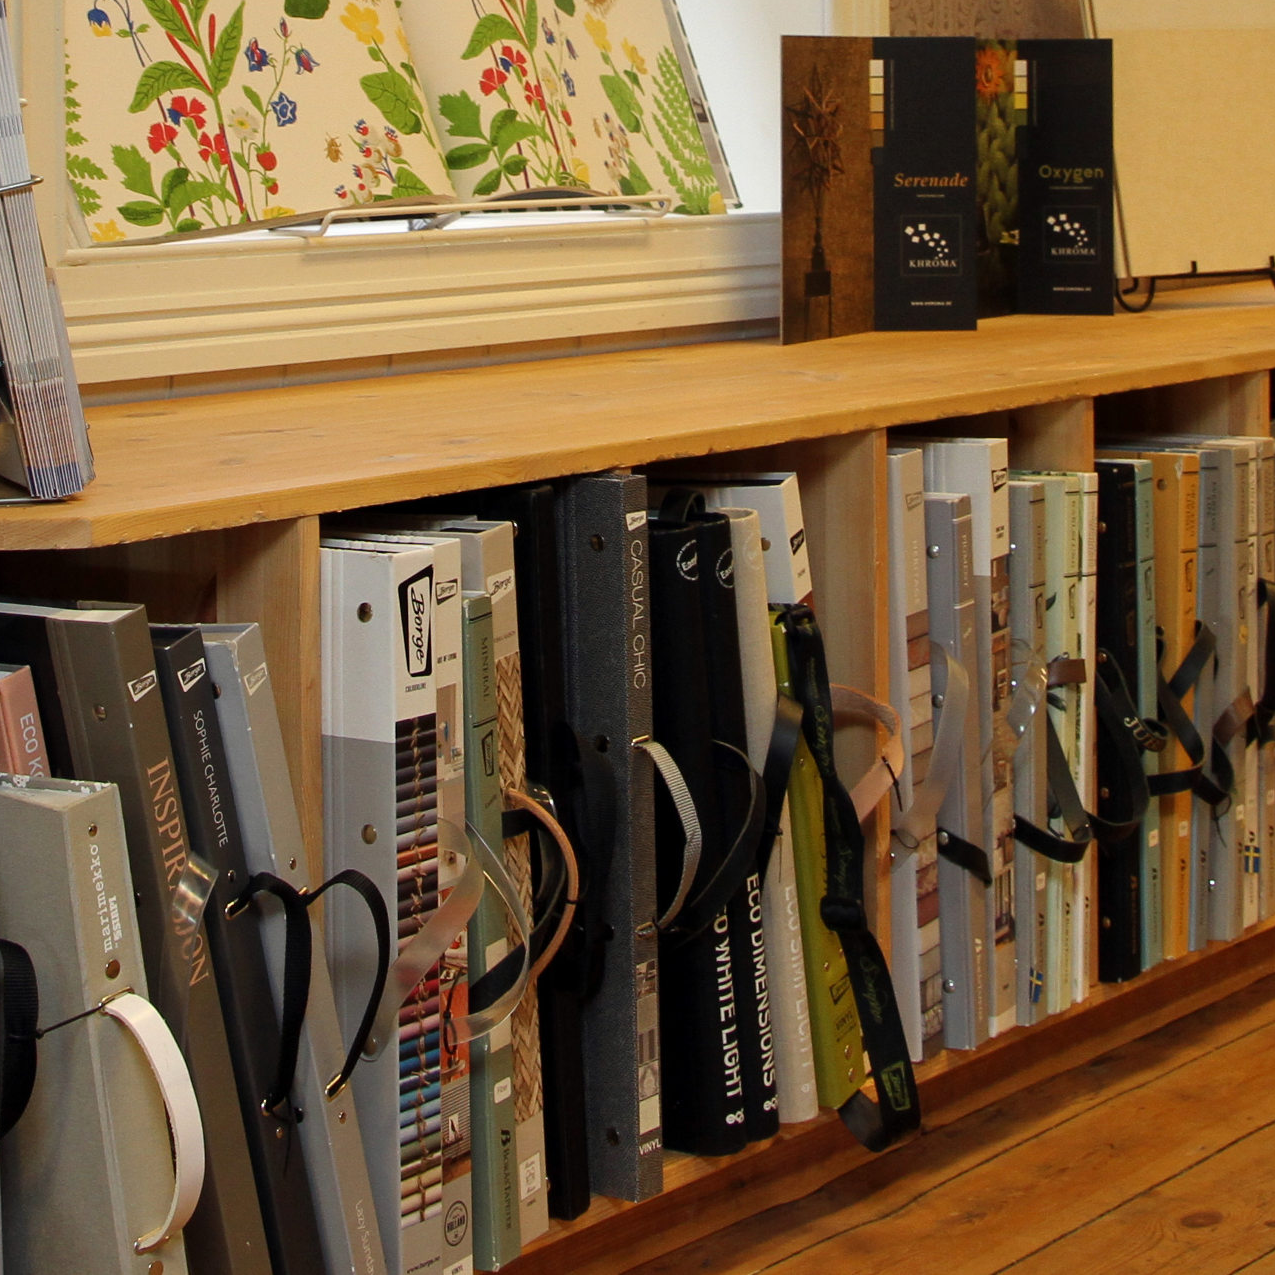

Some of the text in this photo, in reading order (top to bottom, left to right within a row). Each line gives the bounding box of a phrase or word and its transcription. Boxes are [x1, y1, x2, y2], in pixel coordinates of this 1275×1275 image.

[893, 172, 969, 188] Serenade
[1038, 164, 1105, 184] Oxygen
[436, 582, 455, 598] Borge
[411, 586, 426, 665] Borge
[630, 539, 647, 690] CASUAL CHIC
[133, 676, 155, 696] Borge
[183, 662, 203, 686] Borge
[480, 636, 492, 703] MINERAL
[20, 712, 38, 754] ECO
[193, 710, 229, 848] SOPHIE CHARLOTTE
[90, 843, 114, 954] marimekko
[714, 937, 736, 1023] WHITE
[746, 872, 776, 1087] ECO DIMENSIONS
[721, 1024, 743, 1099] LIGHT
[639, 1136, 663, 1156] VINYL
[355, 1198, 366, 1230] Lazy
[446, 1213, 466, 1234] HOLLAND
